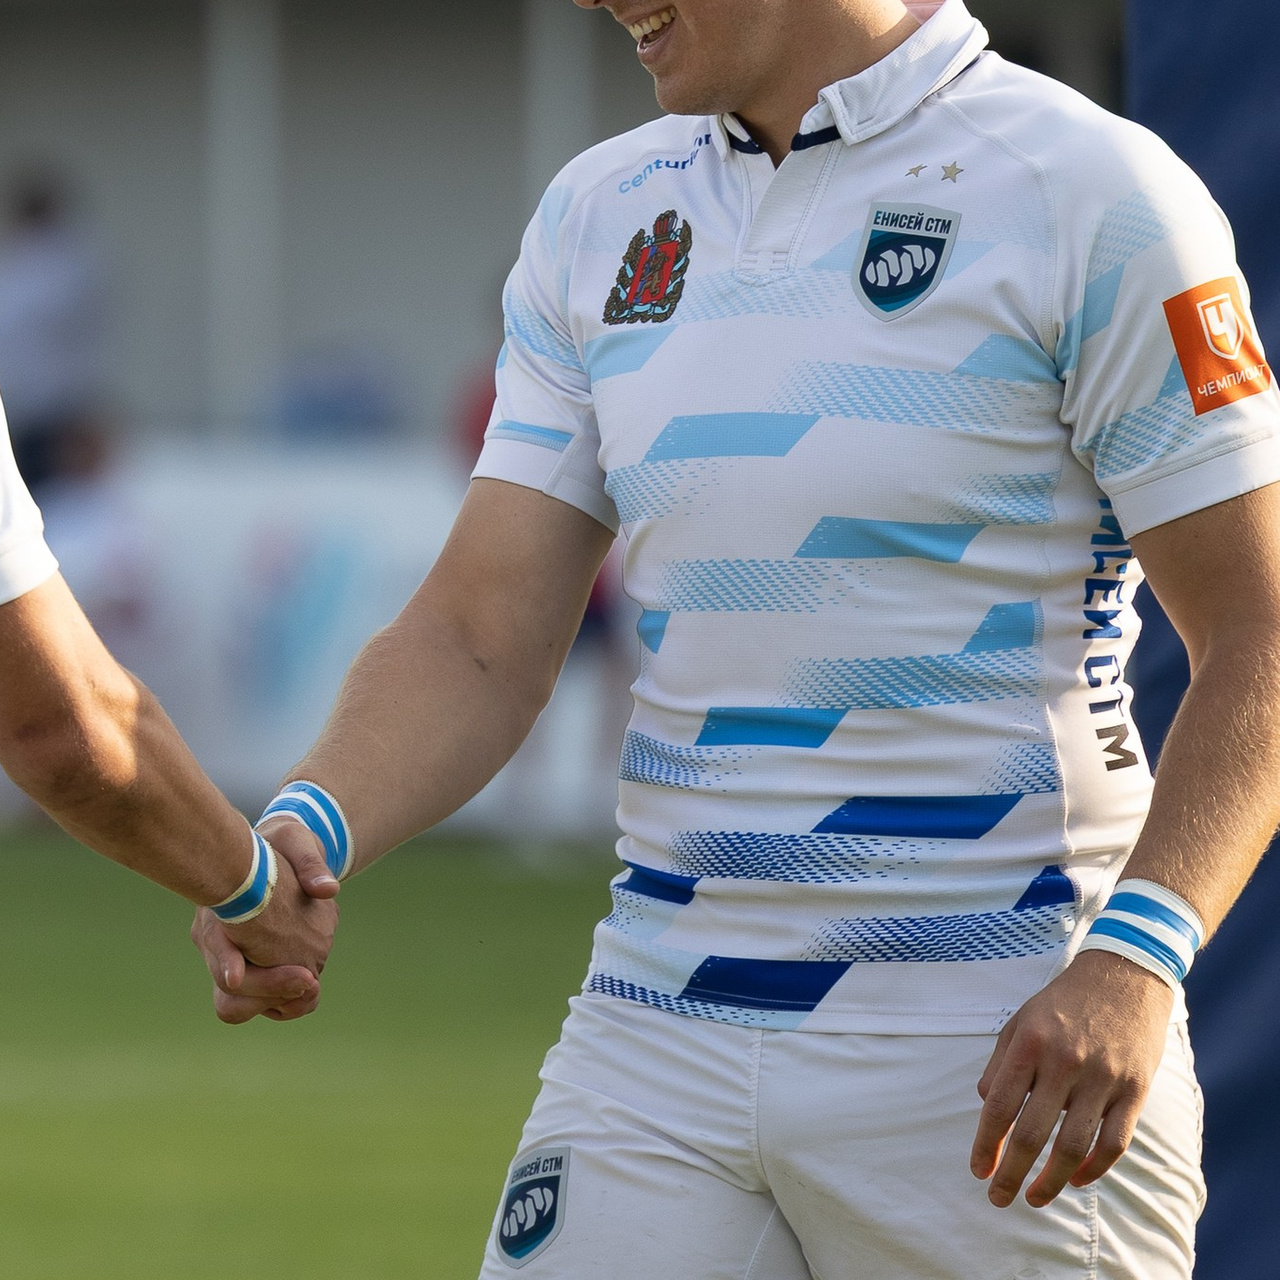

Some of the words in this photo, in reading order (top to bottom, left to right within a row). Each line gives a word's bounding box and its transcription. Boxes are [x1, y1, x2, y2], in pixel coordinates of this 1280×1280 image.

[873, 210, 925, 231] ЕНИСЕЙ
[924, 217, 953, 235] СТМ
[1196, 363, 1266, 397] ЧЕМПИОАТ
[510, 1156, 542, 1184] ЕНИСЕЙ
[541, 1155, 564, 1173] СТМ
